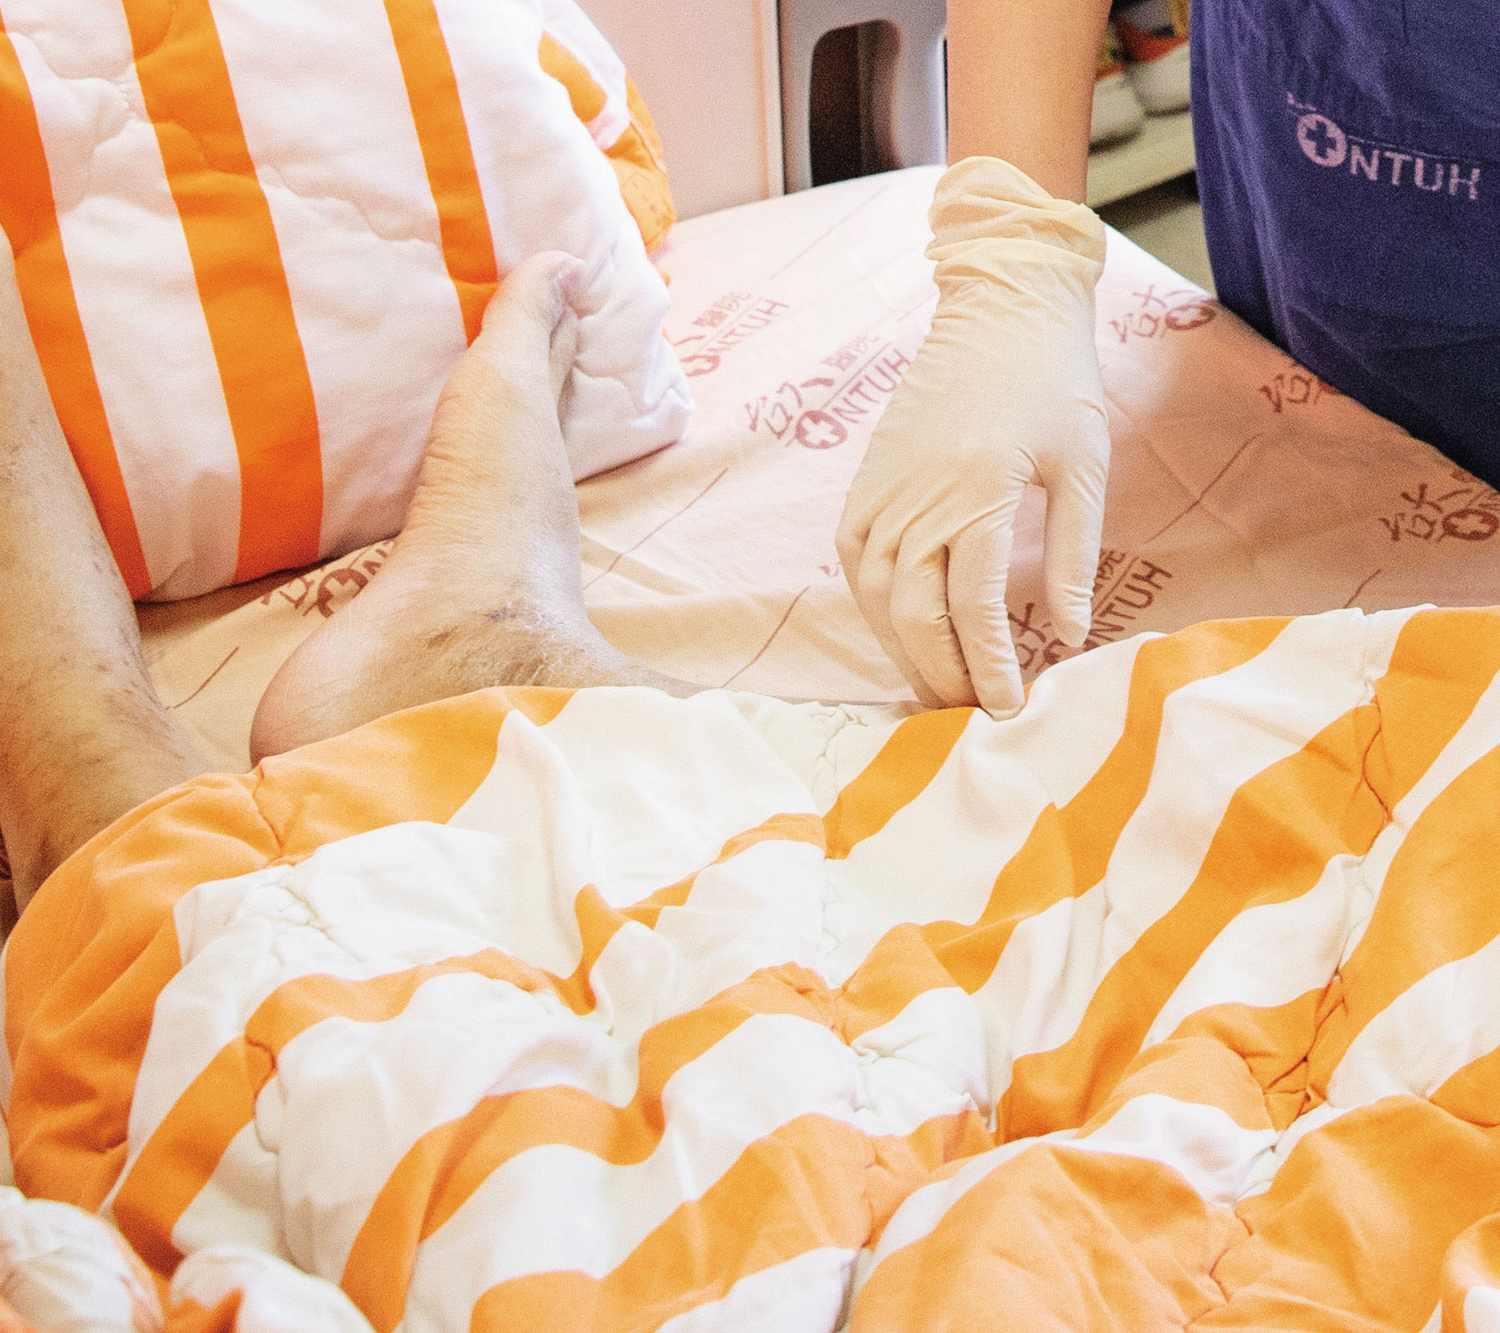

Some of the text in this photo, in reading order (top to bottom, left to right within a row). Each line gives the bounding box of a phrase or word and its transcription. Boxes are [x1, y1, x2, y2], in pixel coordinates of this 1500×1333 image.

[1350, 145, 1481, 201] NTUH
[832, 348, 911, 424] NTUH
[1089, 559, 1173, 643] NTUH
